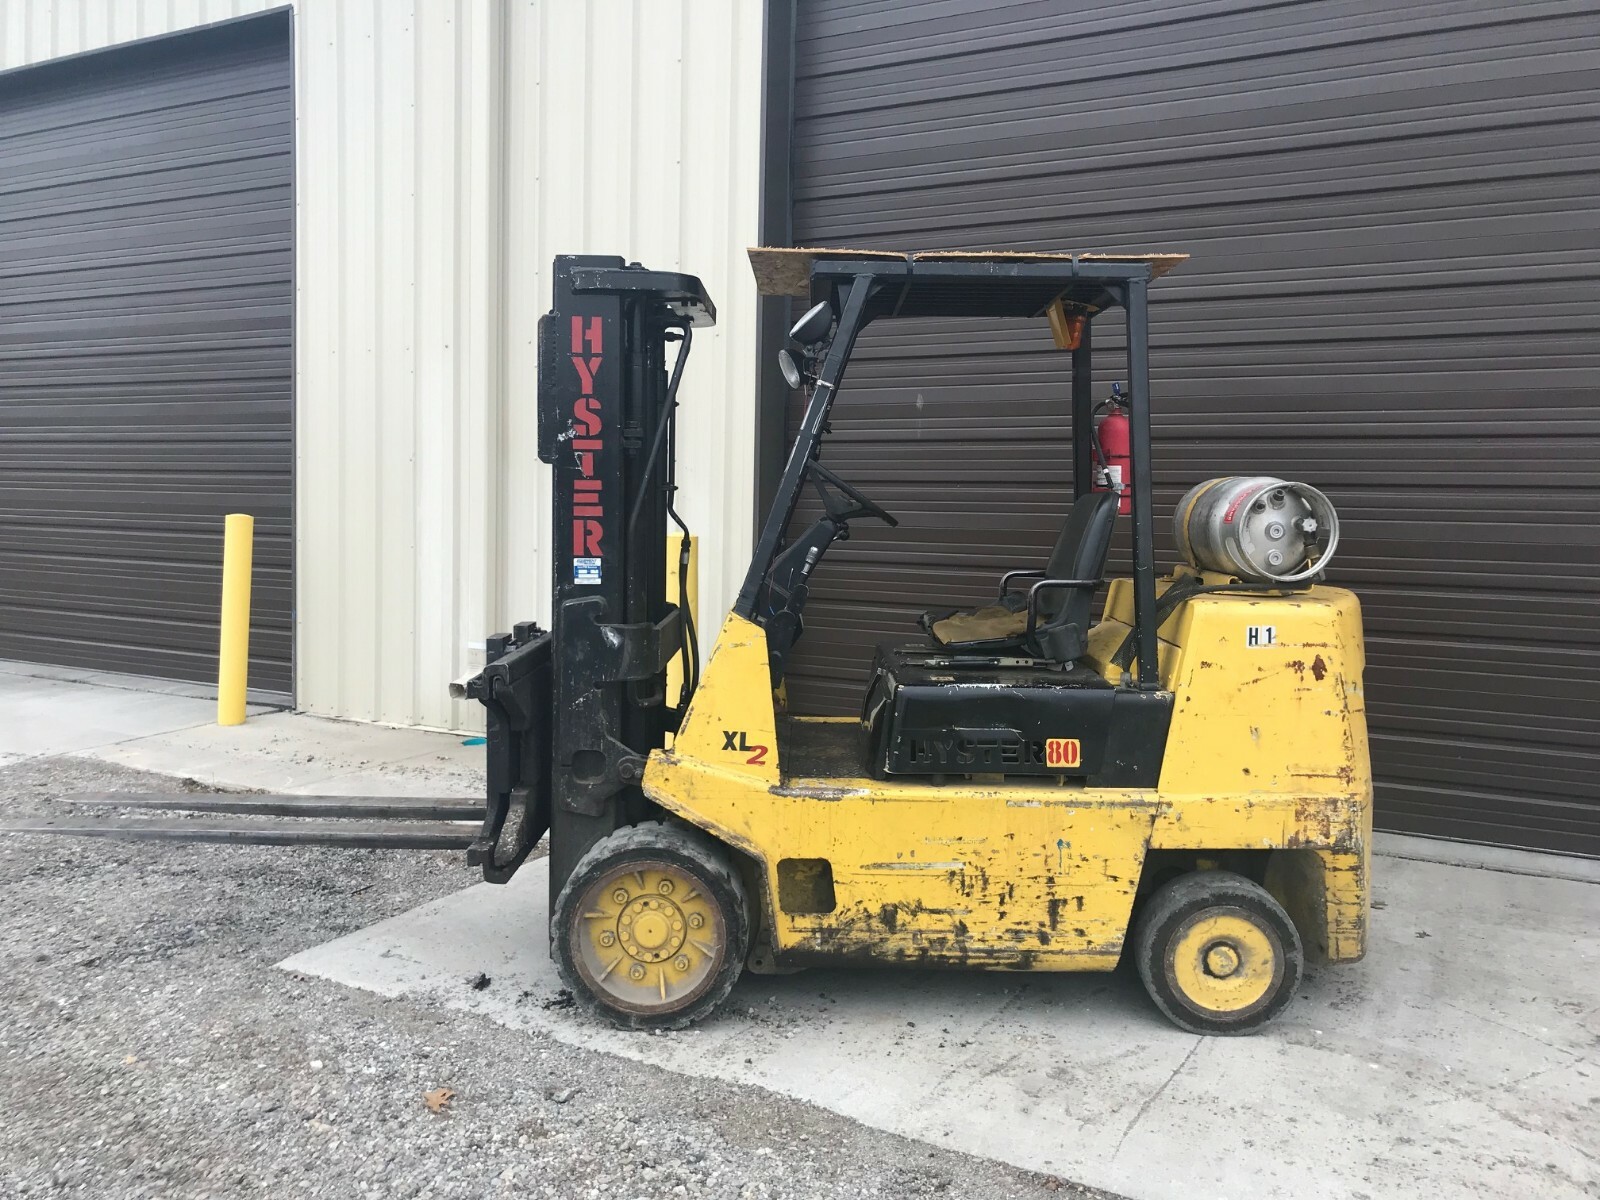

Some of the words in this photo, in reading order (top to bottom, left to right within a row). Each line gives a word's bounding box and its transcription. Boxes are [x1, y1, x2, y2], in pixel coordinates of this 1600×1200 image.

[571, 316, 603, 556] HYSTER
[910, 739, 1046, 764] HYSTER
[1048, 740, 1078, 764] 80
